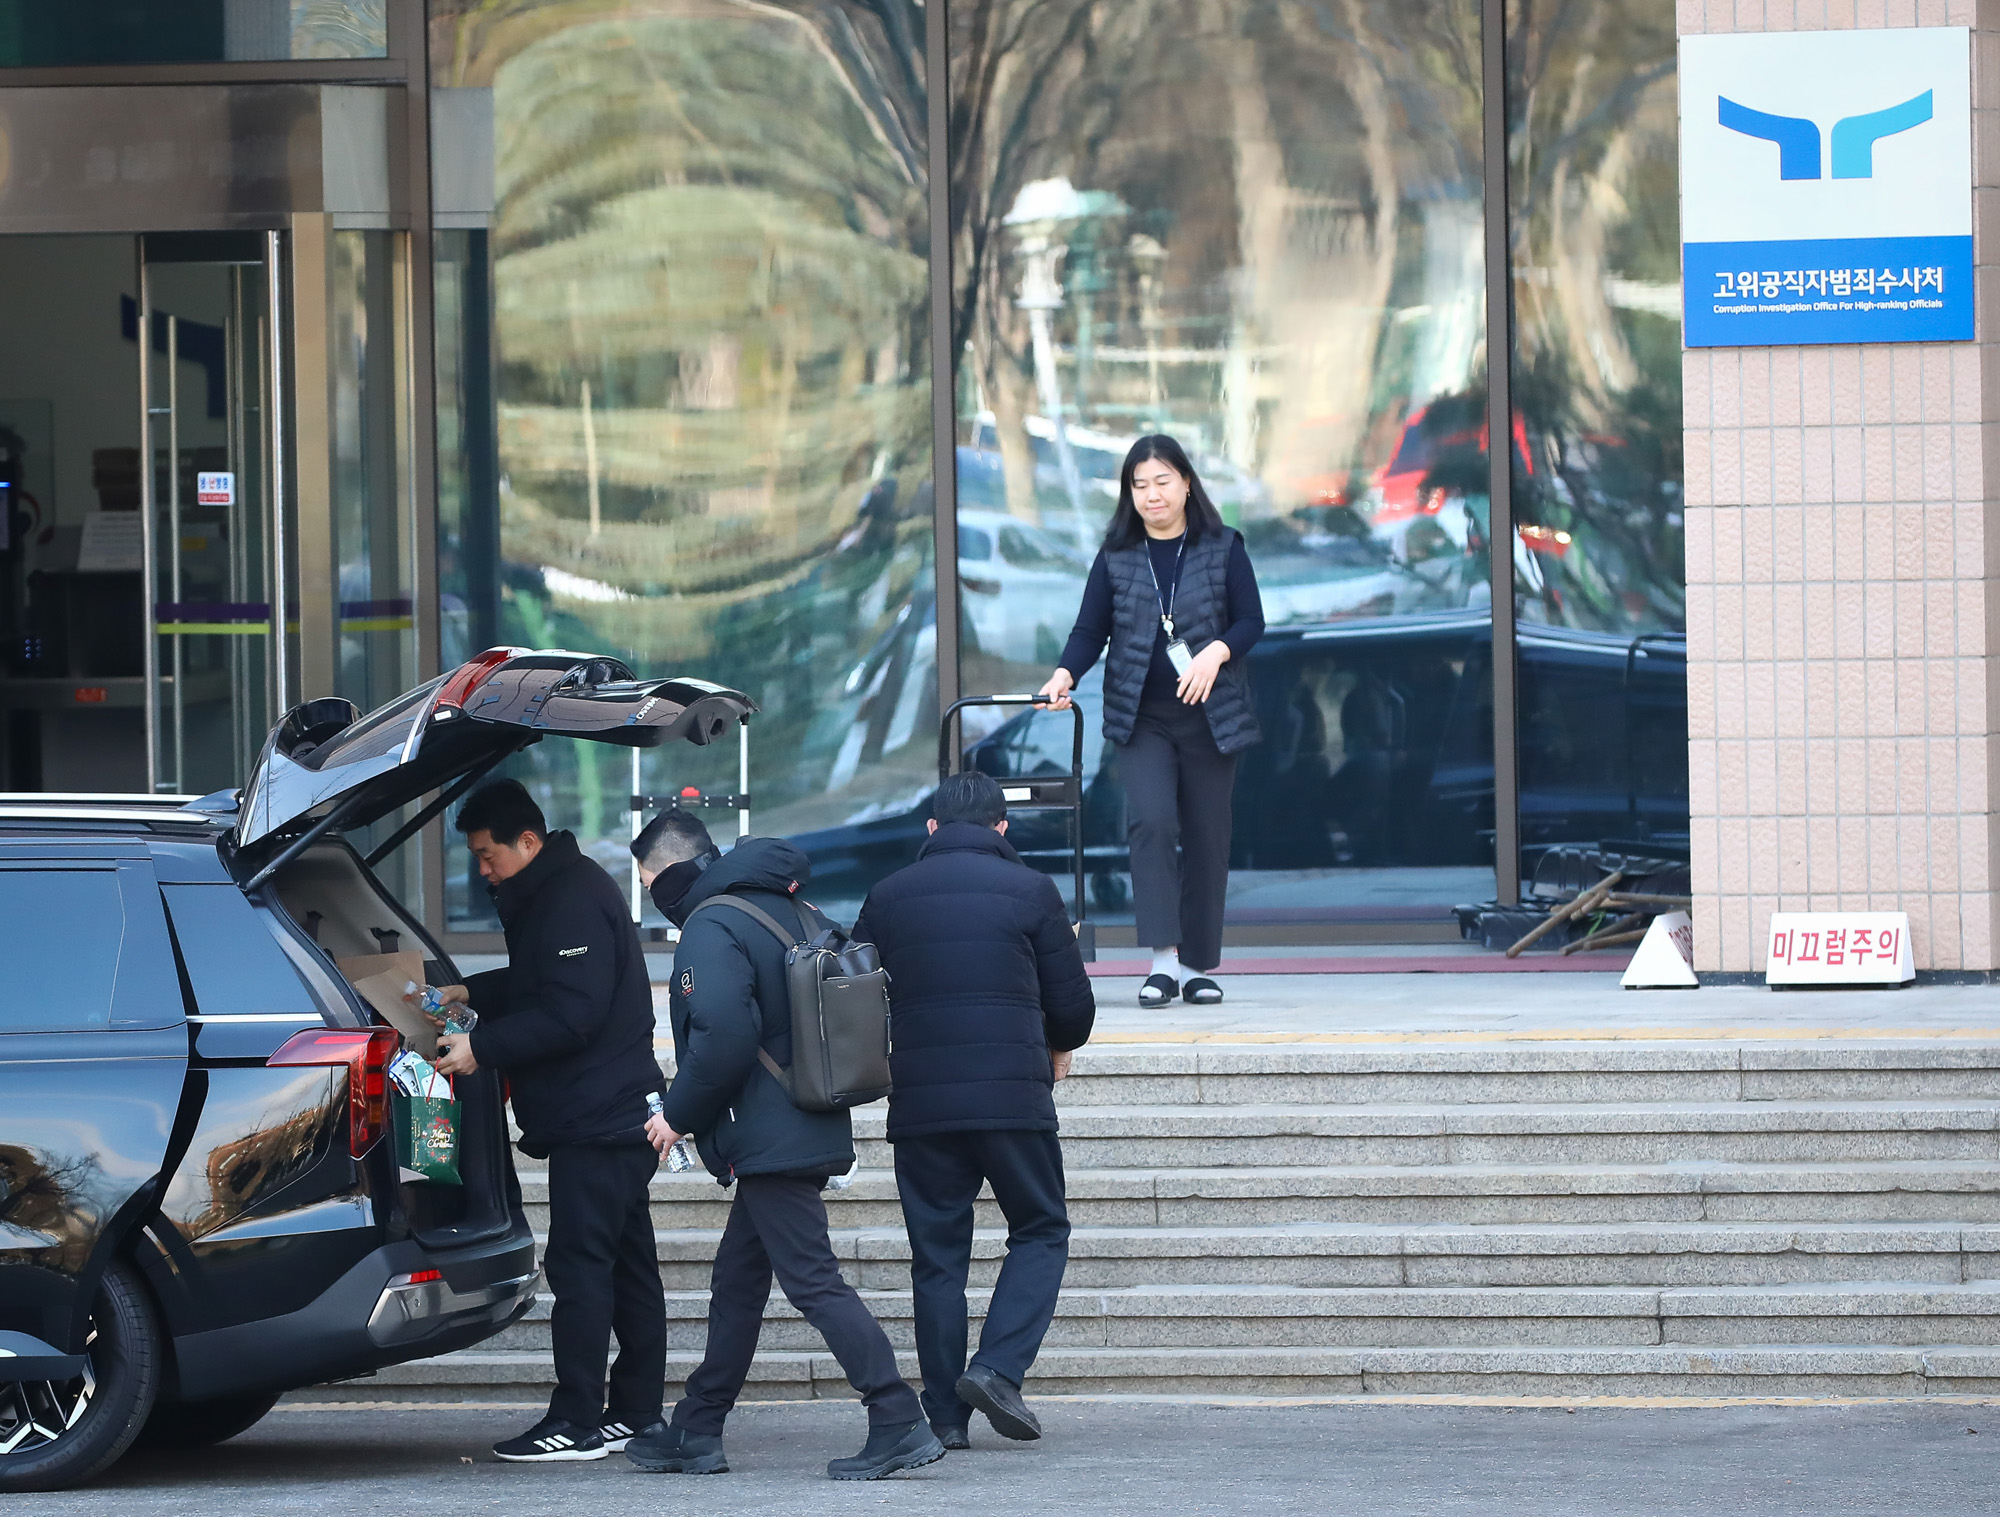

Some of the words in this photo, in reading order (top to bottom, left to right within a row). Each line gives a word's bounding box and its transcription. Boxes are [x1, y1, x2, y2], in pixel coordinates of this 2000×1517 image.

[1713, 266, 1943, 299] 고위공직자범죄수사처
[1713, 303, 1757, 315] Corruption
[1758, 302, 1812, 314] Investigation
[1813, 301, 1838, 311] Office
[1839, 301, 1854, 310] For
[1854, 300, 1908, 312] High-ranking
[1909, 299, 1943, 309] Officials
[1773, 928, 1900, 966] 미끄럼주의
[430, 1128, 451, 1143] Merry
